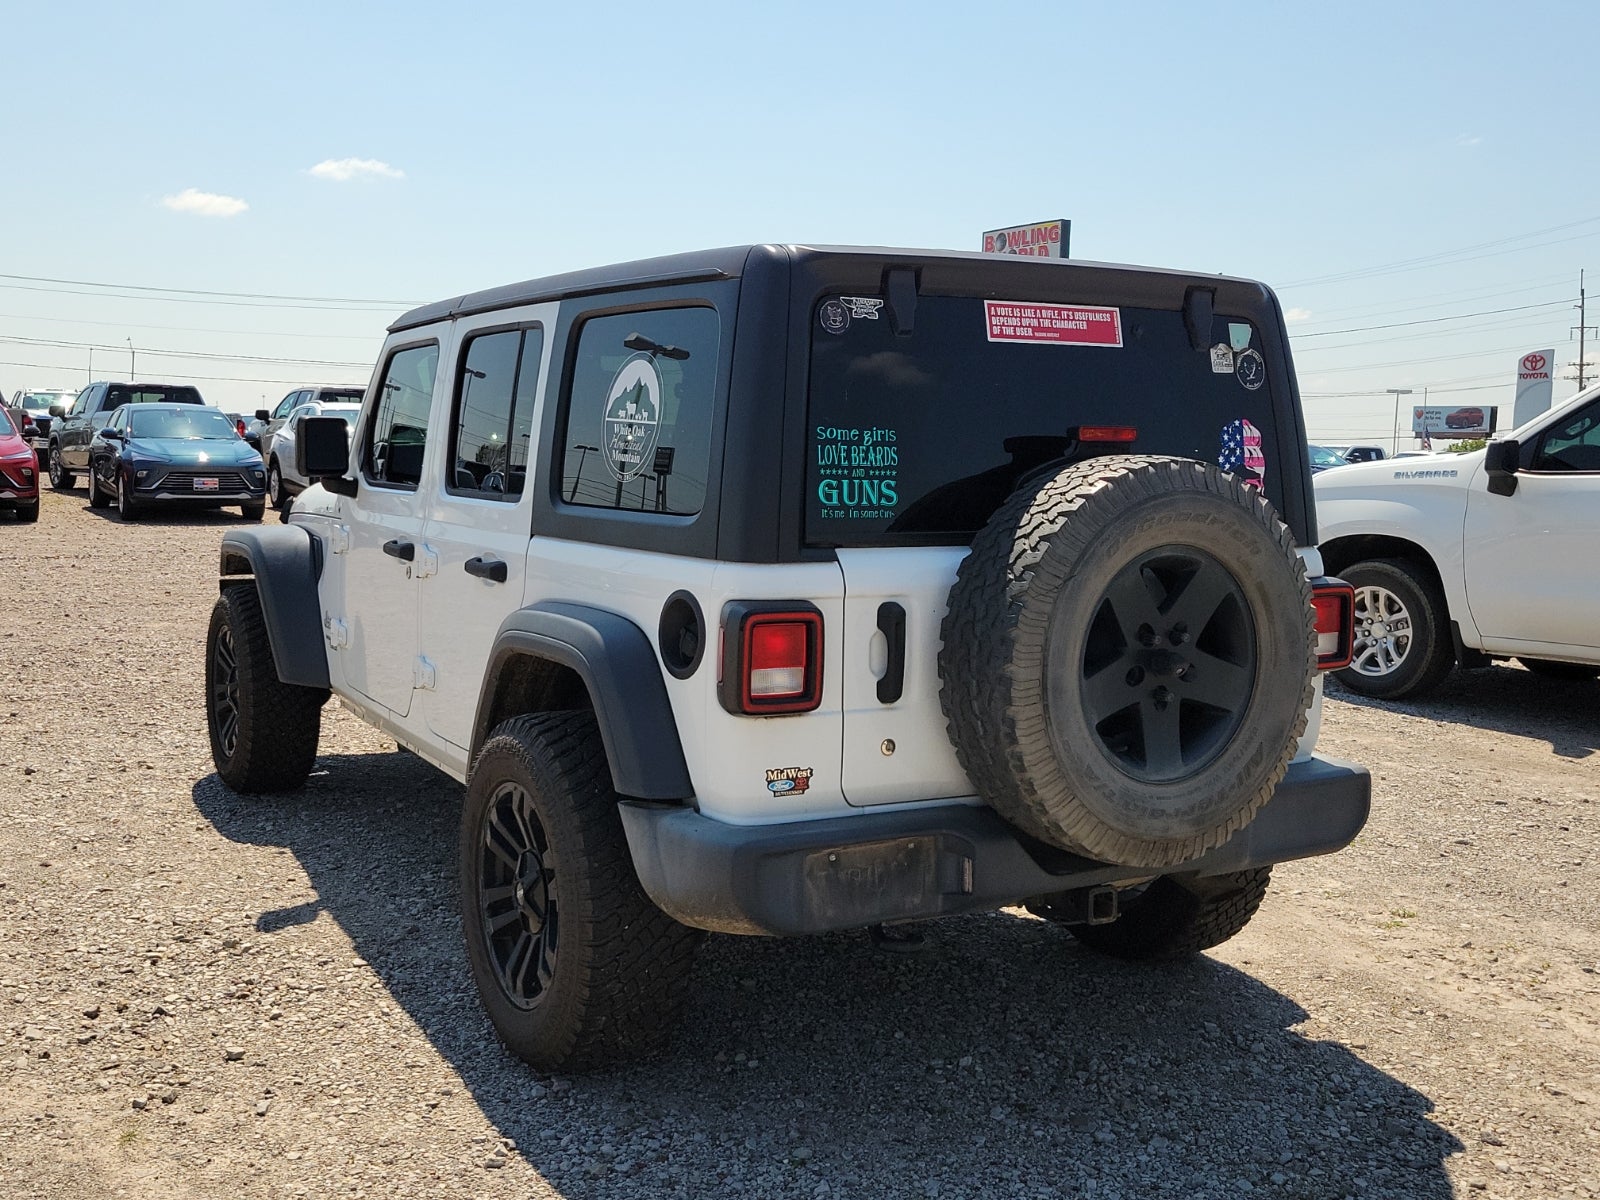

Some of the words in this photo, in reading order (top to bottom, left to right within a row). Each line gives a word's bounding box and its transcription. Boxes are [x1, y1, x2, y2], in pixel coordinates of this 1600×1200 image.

[991, 307, 996, 316] A
[996, 307, 1013, 317] VOTE
[1014, 308, 1021, 317] IS
[1021, 309, 1036, 318] LIKE
[1037, 310, 1042, 318] A
[1061, 311, 1073, 320] IT'S
[1074, 312, 1111, 322] USEFULNESS
[992, 317, 1021, 326] DEPENDS
[1022, 318, 1039, 327] UPON
[1039, 319, 1052, 328] THE
[1052, 320, 1088, 330] CHARACTER
[993, 326, 1001, 335] OF
[1002, 327, 1015, 336] THE
[614, 423, 632, 436] White
[632, 425, 646, 437] Oak
[816, 426, 860, 441] Some
[863, 426, 897, 446] girls
[612, 450, 641, 464] Mountain
[817, 442, 849, 467] LOVE
[850, 445, 898, 467] BEARDS
[851, 468, 866, 478] AND
[818, 479, 899, 506] GUNS
[768, 769, 811, 780] MidWest
